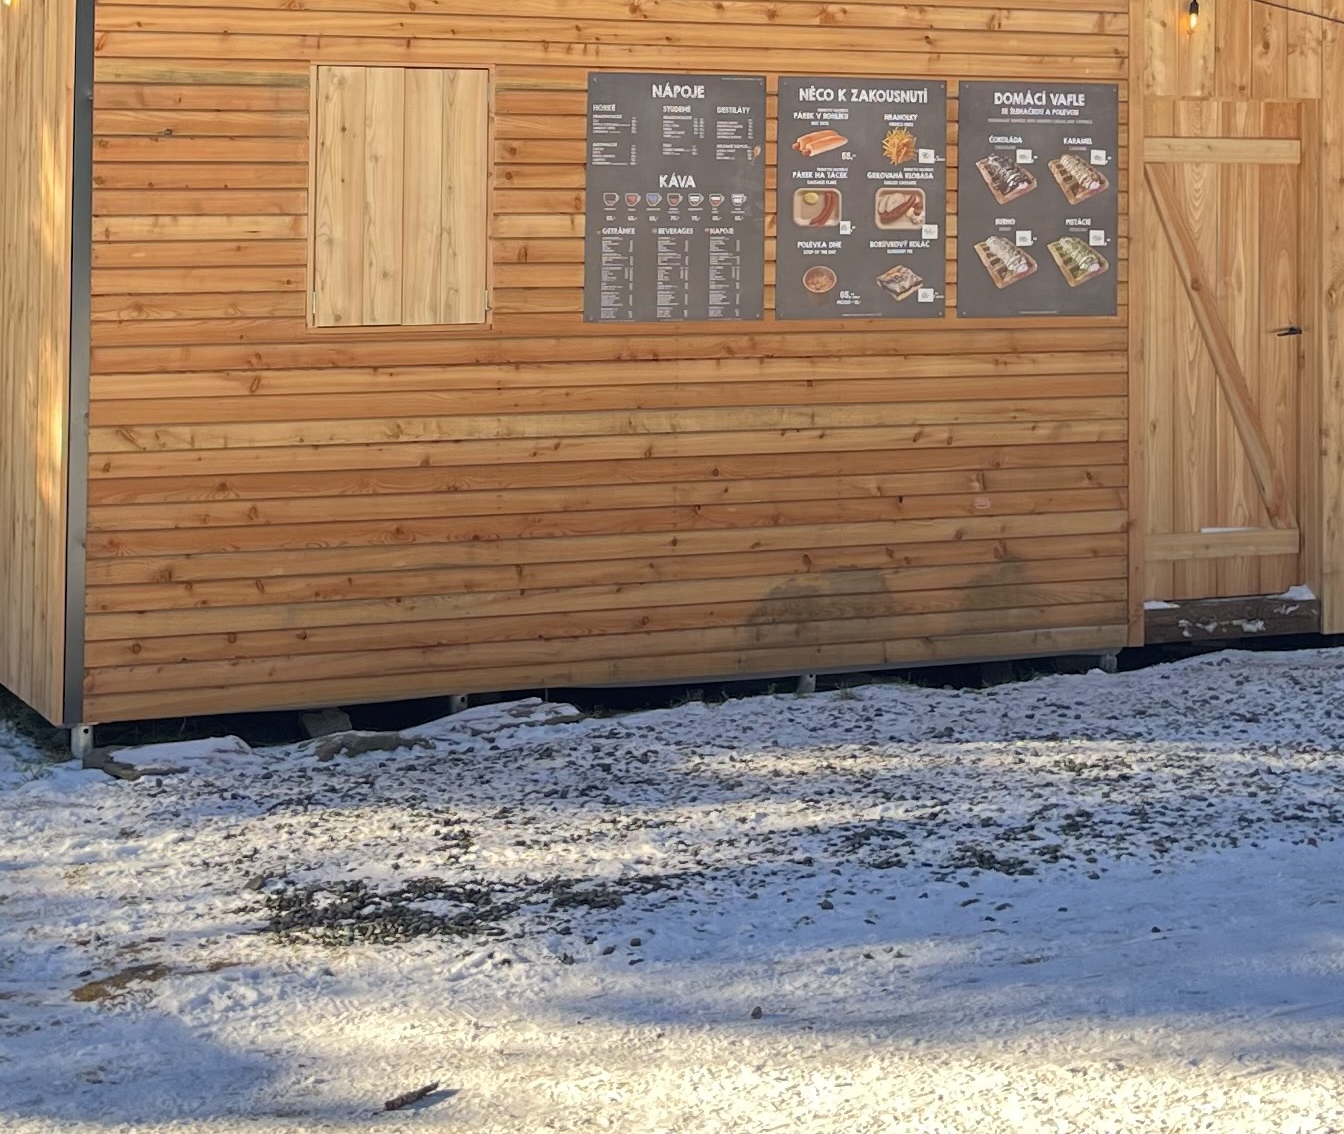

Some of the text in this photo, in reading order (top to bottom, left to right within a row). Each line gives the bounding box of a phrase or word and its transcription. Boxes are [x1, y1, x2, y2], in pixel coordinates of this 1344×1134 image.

[651, 81, 705, 99] NÁPOJE
[799, 85, 928, 104] NĚCO K ZAKOUSNUTÍ
[993, 90, 1086, 107] DOMÁCÍ VAFLE
[659, 172, 697, 189] KÁVA
